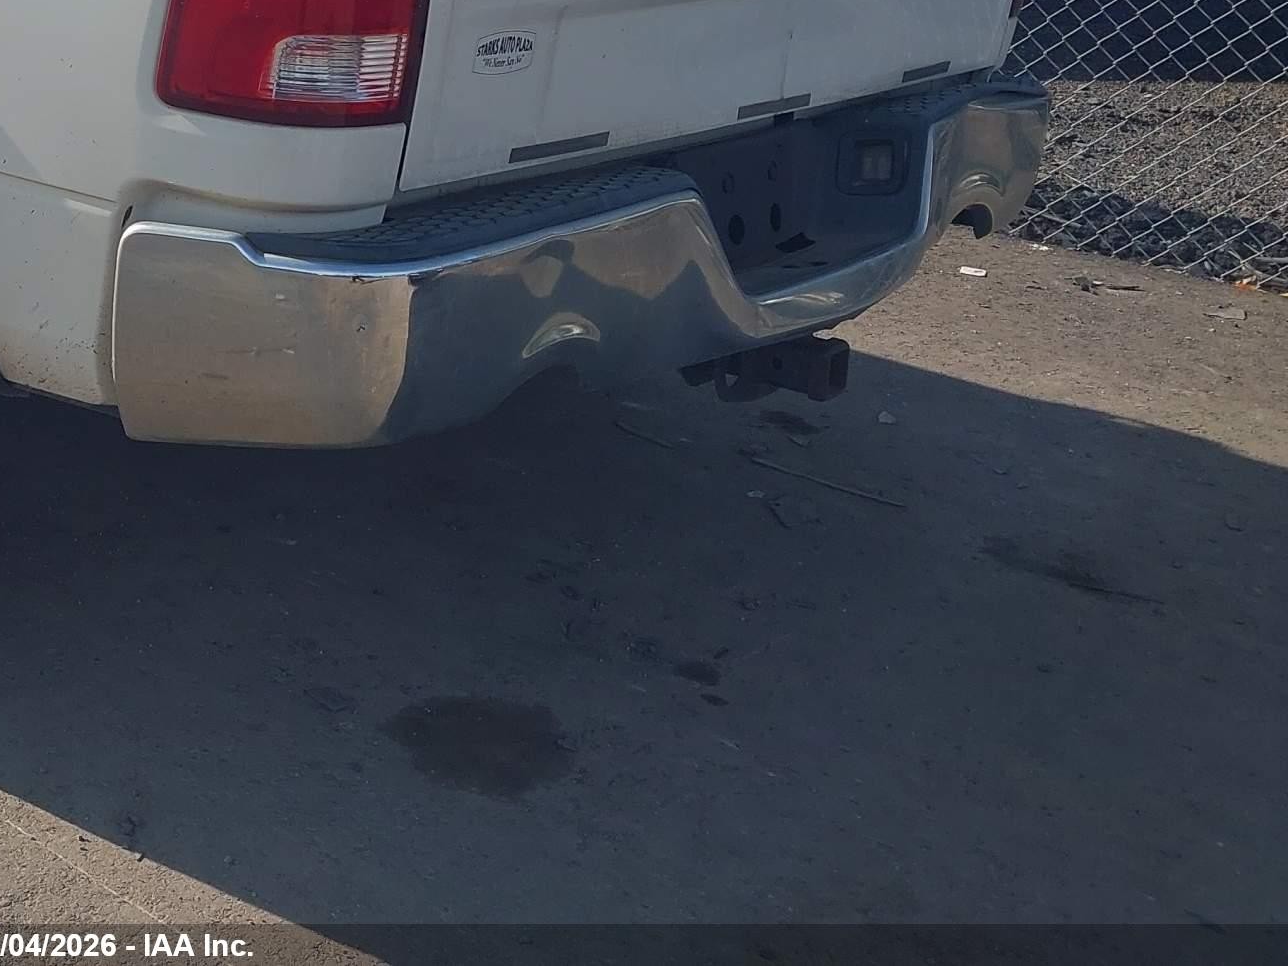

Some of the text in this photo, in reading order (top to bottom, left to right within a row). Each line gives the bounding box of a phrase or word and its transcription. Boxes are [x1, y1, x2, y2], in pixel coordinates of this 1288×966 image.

[476, 35, 533, 57] STARKS AUTO PLAZA
